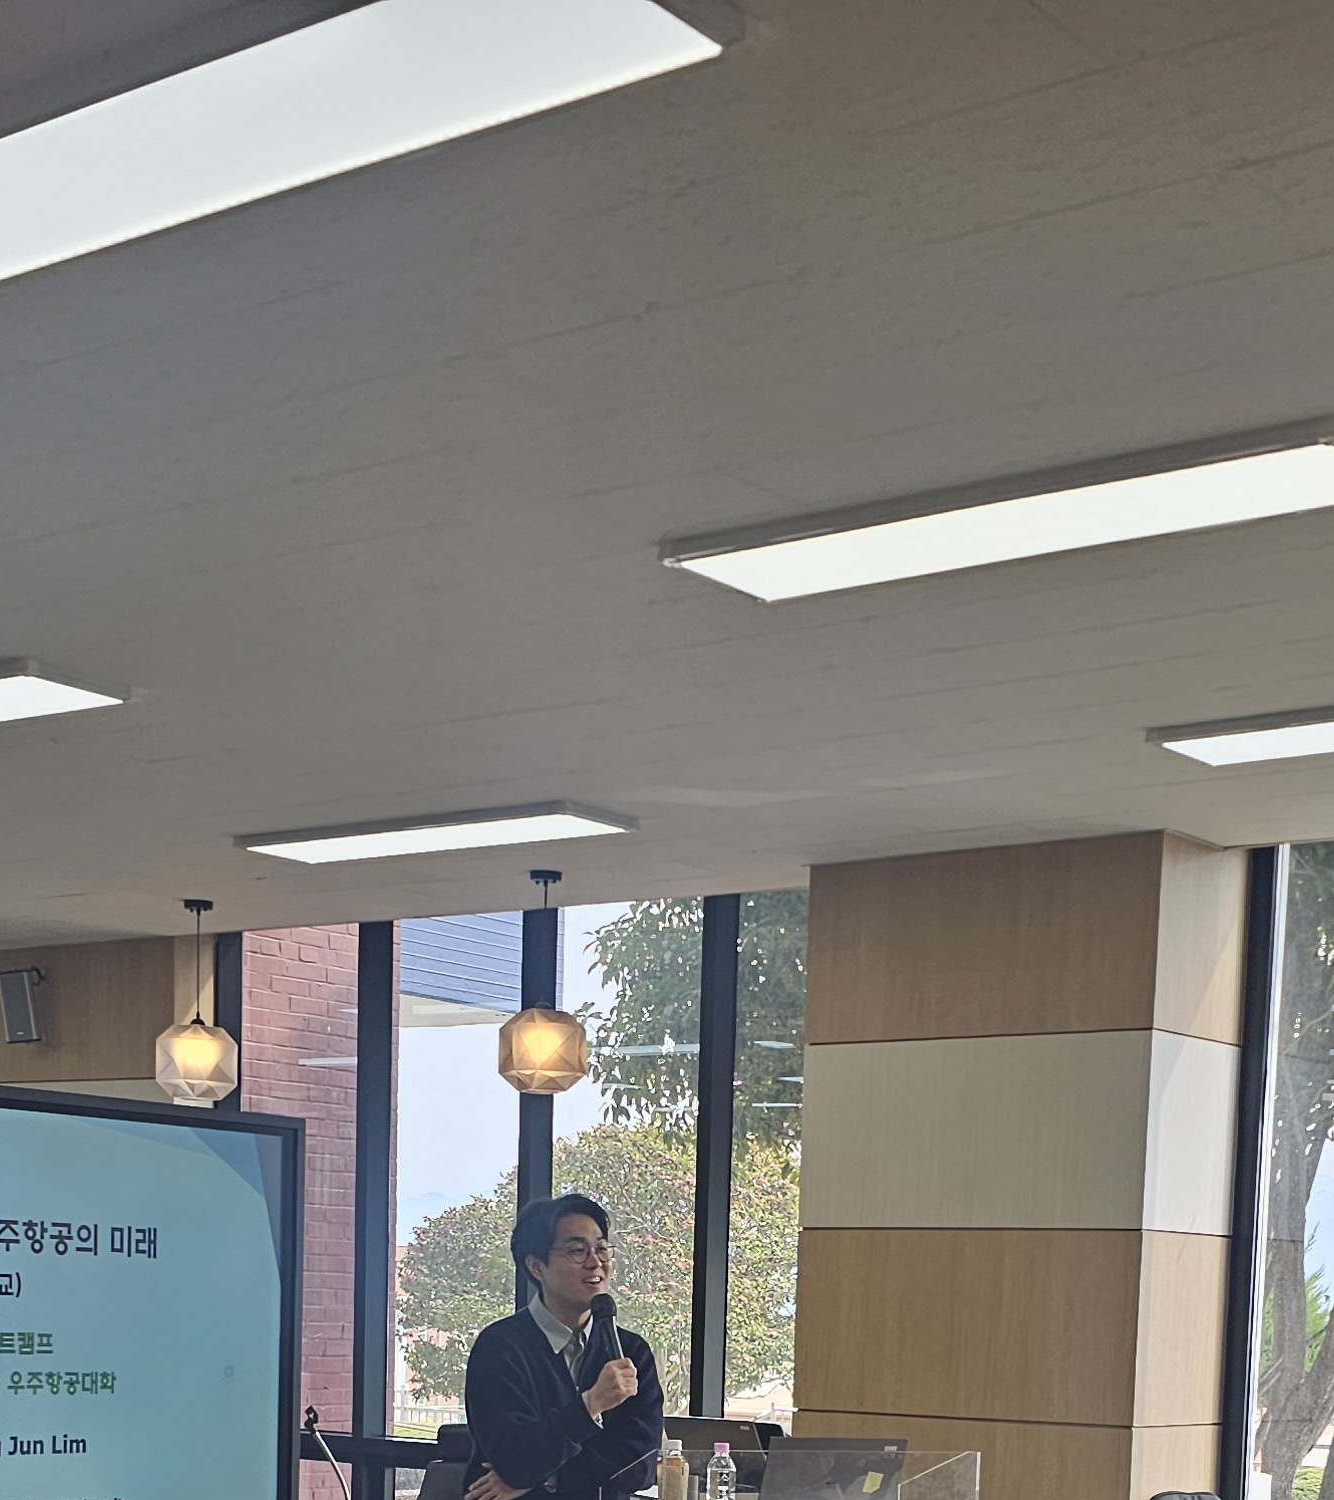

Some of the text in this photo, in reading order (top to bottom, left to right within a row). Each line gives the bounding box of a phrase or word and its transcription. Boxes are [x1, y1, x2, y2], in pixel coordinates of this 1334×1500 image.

[110, 1226, 157, 1259] 미래
[7, 1371, 117, 1396] 우주항공대학
[8, 1436, 44, 1456] Jun
[52, 1434, 87, 1454] Lim
